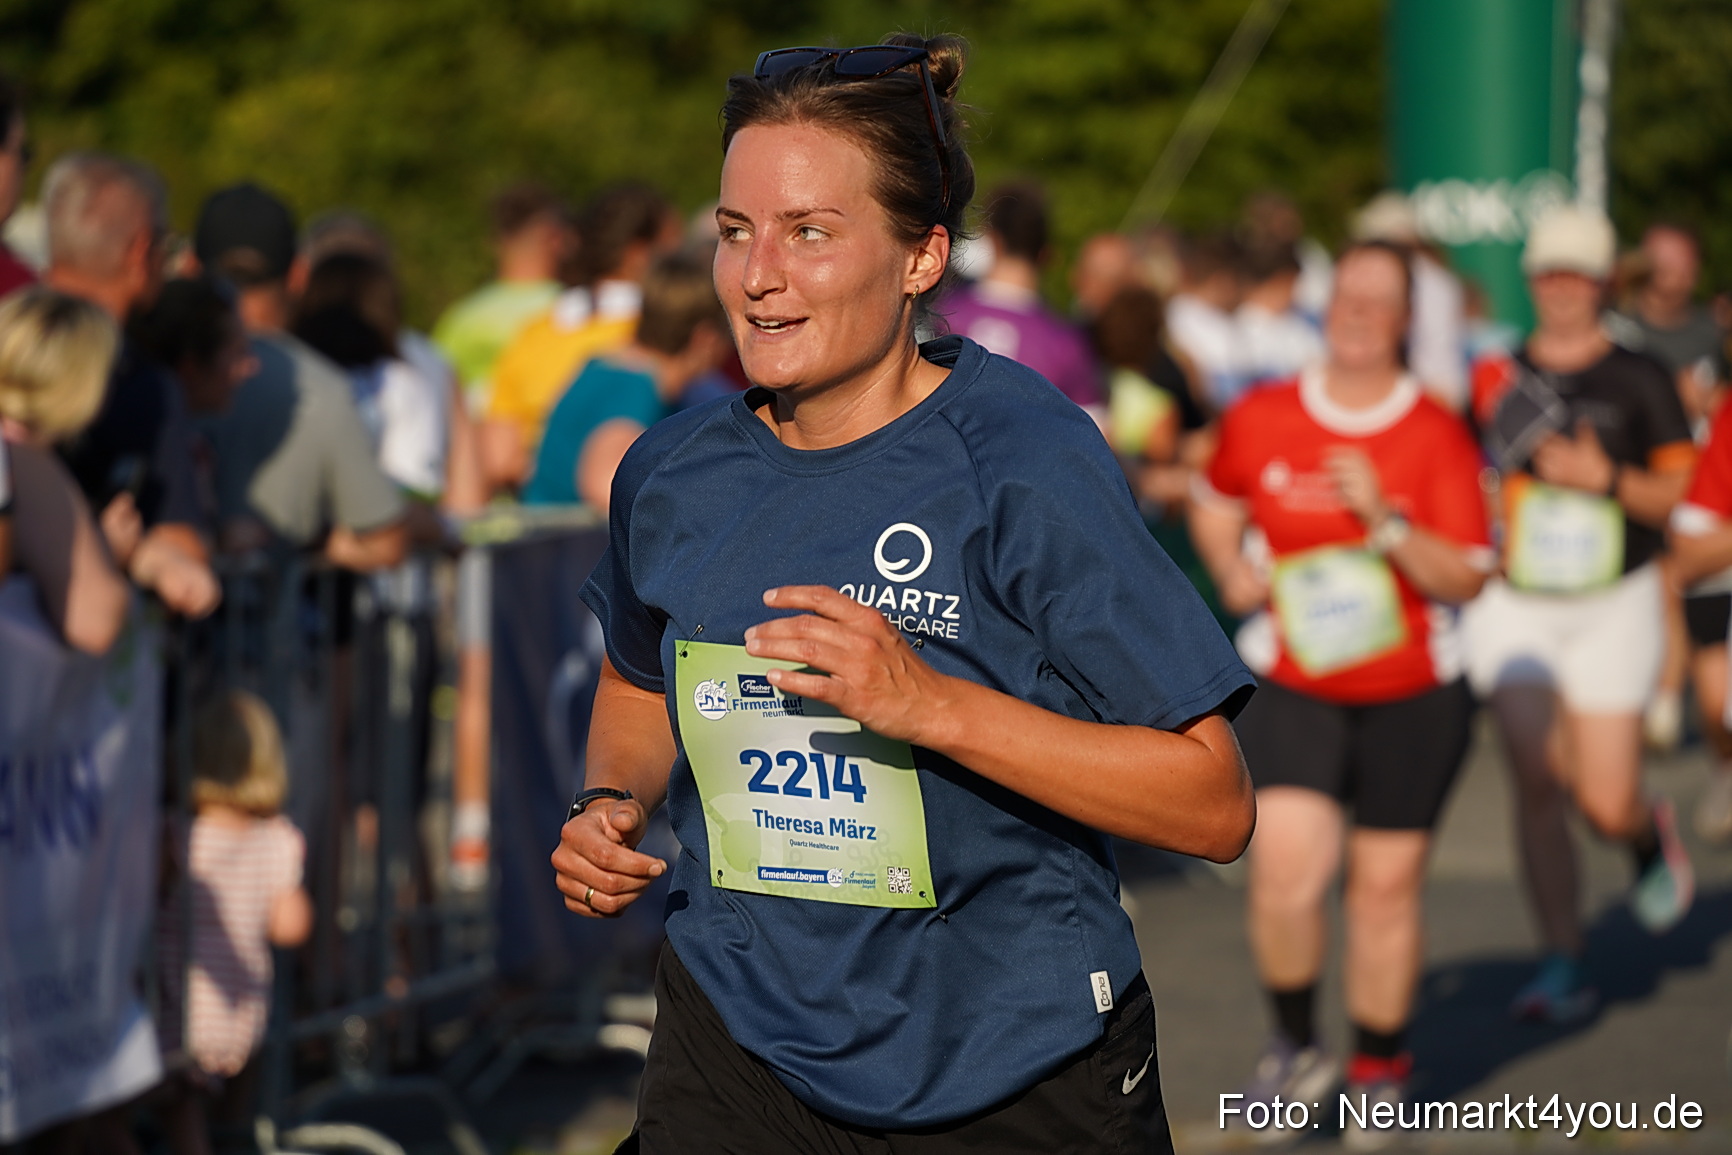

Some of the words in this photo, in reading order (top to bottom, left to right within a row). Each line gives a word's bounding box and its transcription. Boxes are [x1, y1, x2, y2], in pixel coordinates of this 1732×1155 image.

[882, 613, 960, 639] HCARE
[732, 697, 803, 711] Firmenlauf
[762, 708, 805, 718] neumarkt
[739, 749, 867, 803] 2214
[752, 808, 825, 836] Theresa
[829, 817, 877, 841] März
[789, 838, 808, 847] Quartz
[808, 841, 840, 851] Healthcare
[760, 869, 825, 883] firmenlauf.bayern
